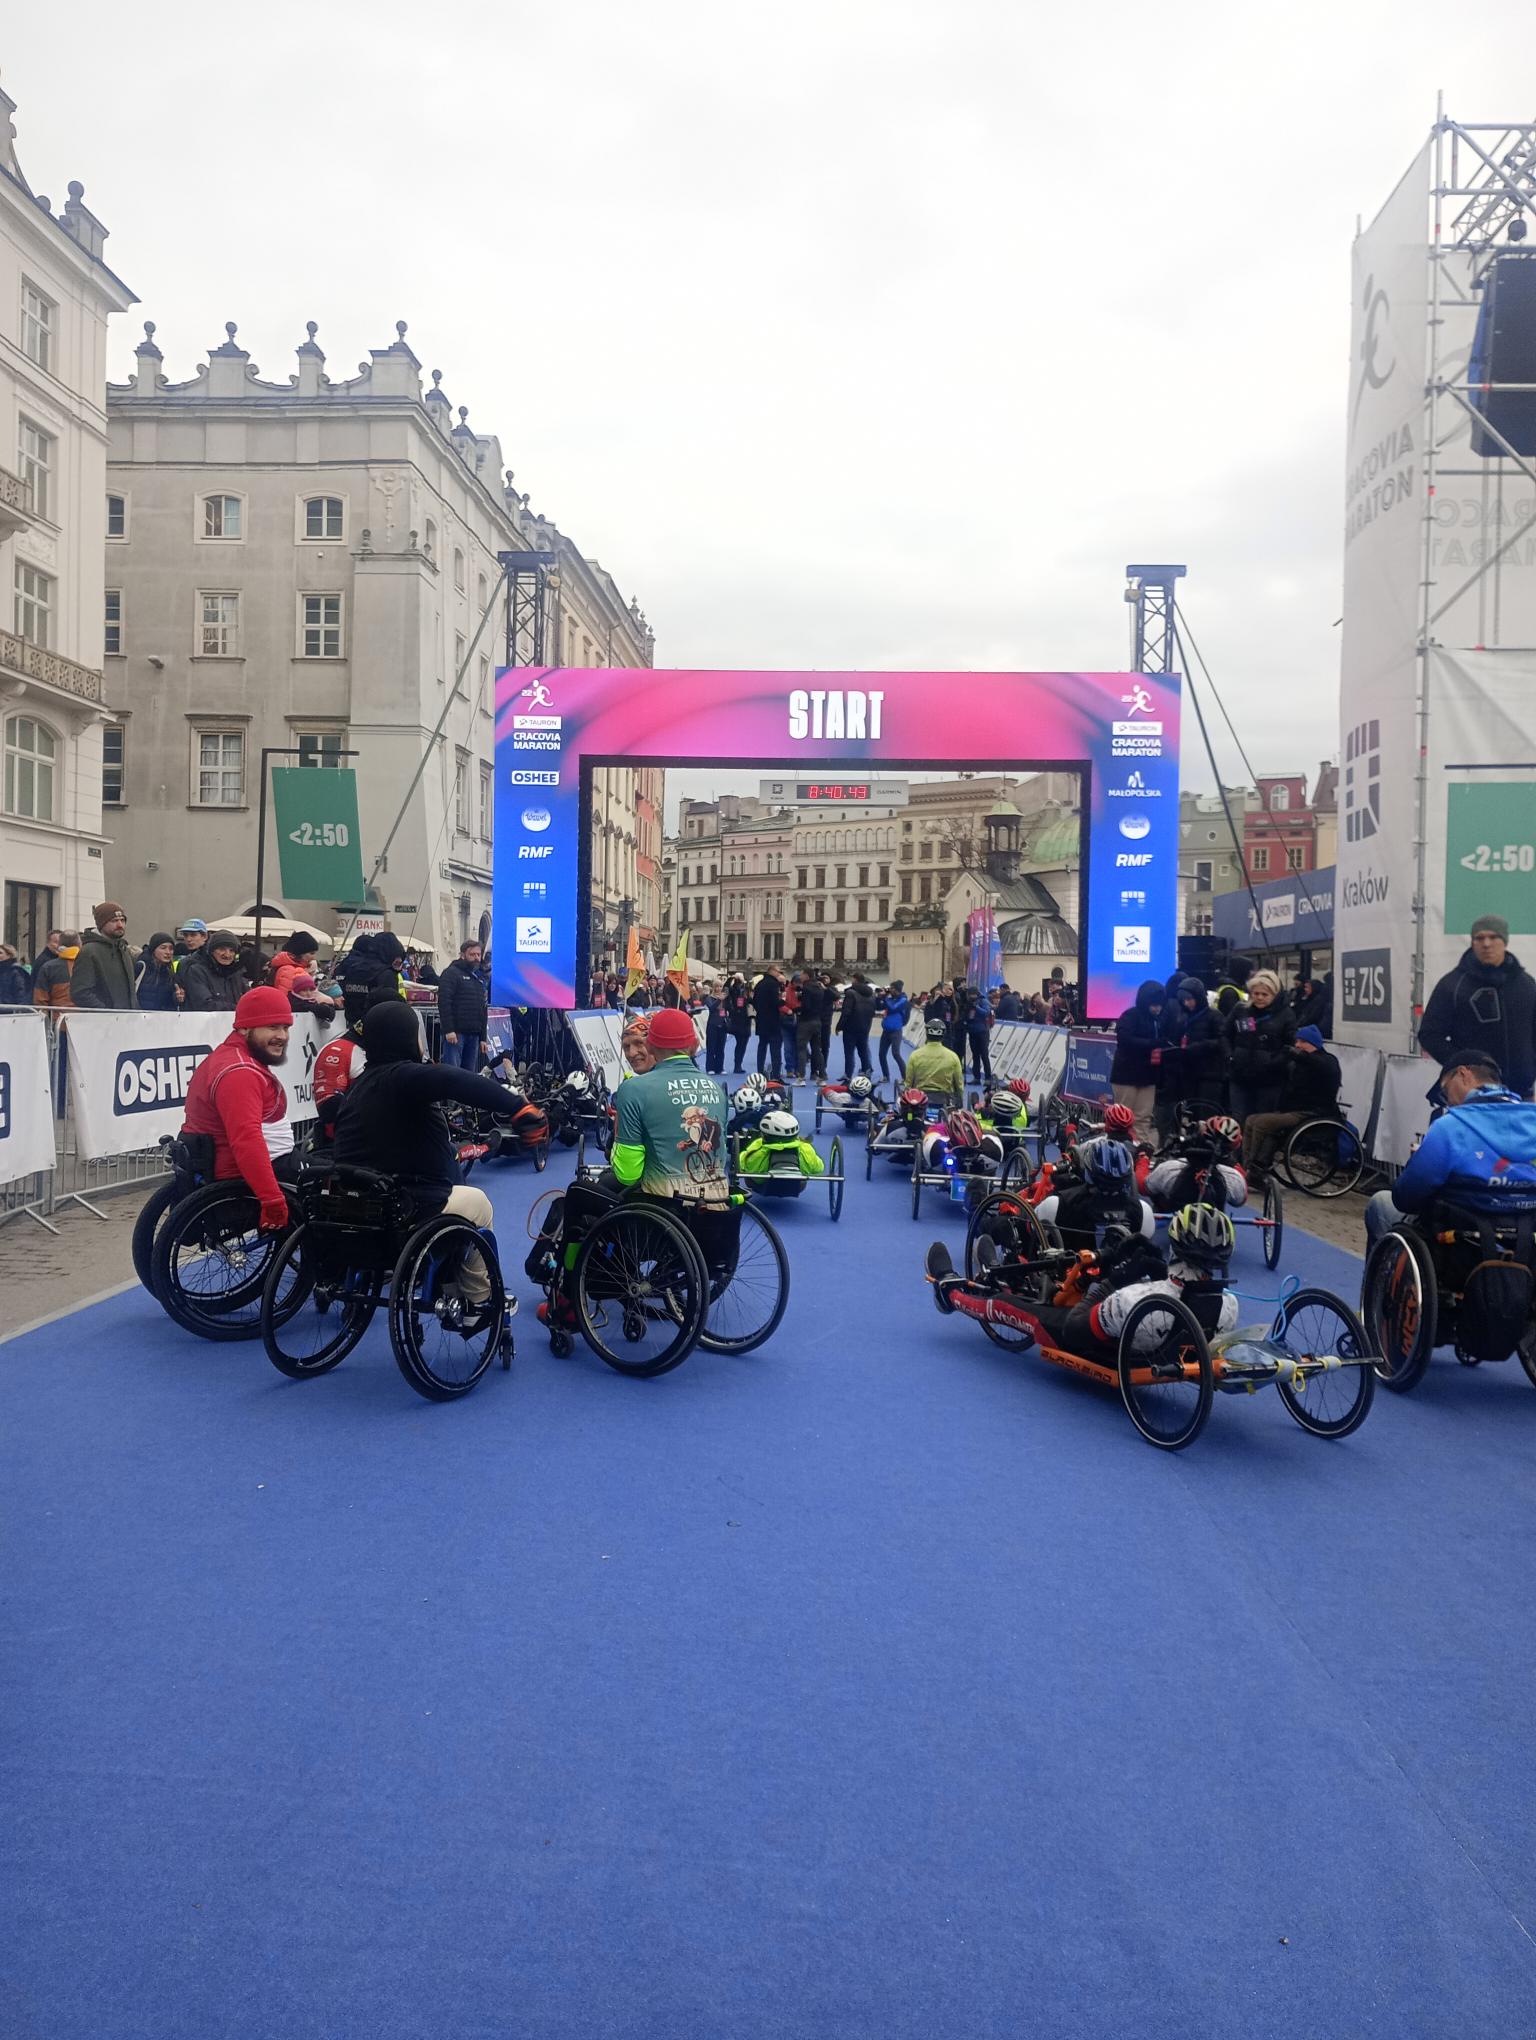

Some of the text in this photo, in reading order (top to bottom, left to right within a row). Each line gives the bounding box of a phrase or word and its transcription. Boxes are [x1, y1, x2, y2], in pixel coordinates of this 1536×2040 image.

[789, 689, 884, 739] START
[513, 732, 561, 741] CRACOVIA
[1112, 738, 1162, 747] CRACOVIA
[513, 741, 561, 750] MARATON
[1112, 748, 1162, 757] MARATON
[514, 772, 557, 783] OSHEE
[1108, 789, 1162, 798] MAŁOPOLSKA
[289, 822, 349, 847] <2:50
[518, 846, 554, 859] RMF
[1461, 845, 1535, 872] <2:50
[1116, 853, 1154, 867] RMF
[1342, 868, 1389, 909] Kraków
[1359, 966, 1385, 1007] ZIS
[667, 1078, 717, 1090] NEVER
[294, 1083, 314, 1104] TAU
[702, 1094, 720, 1104] MAN
